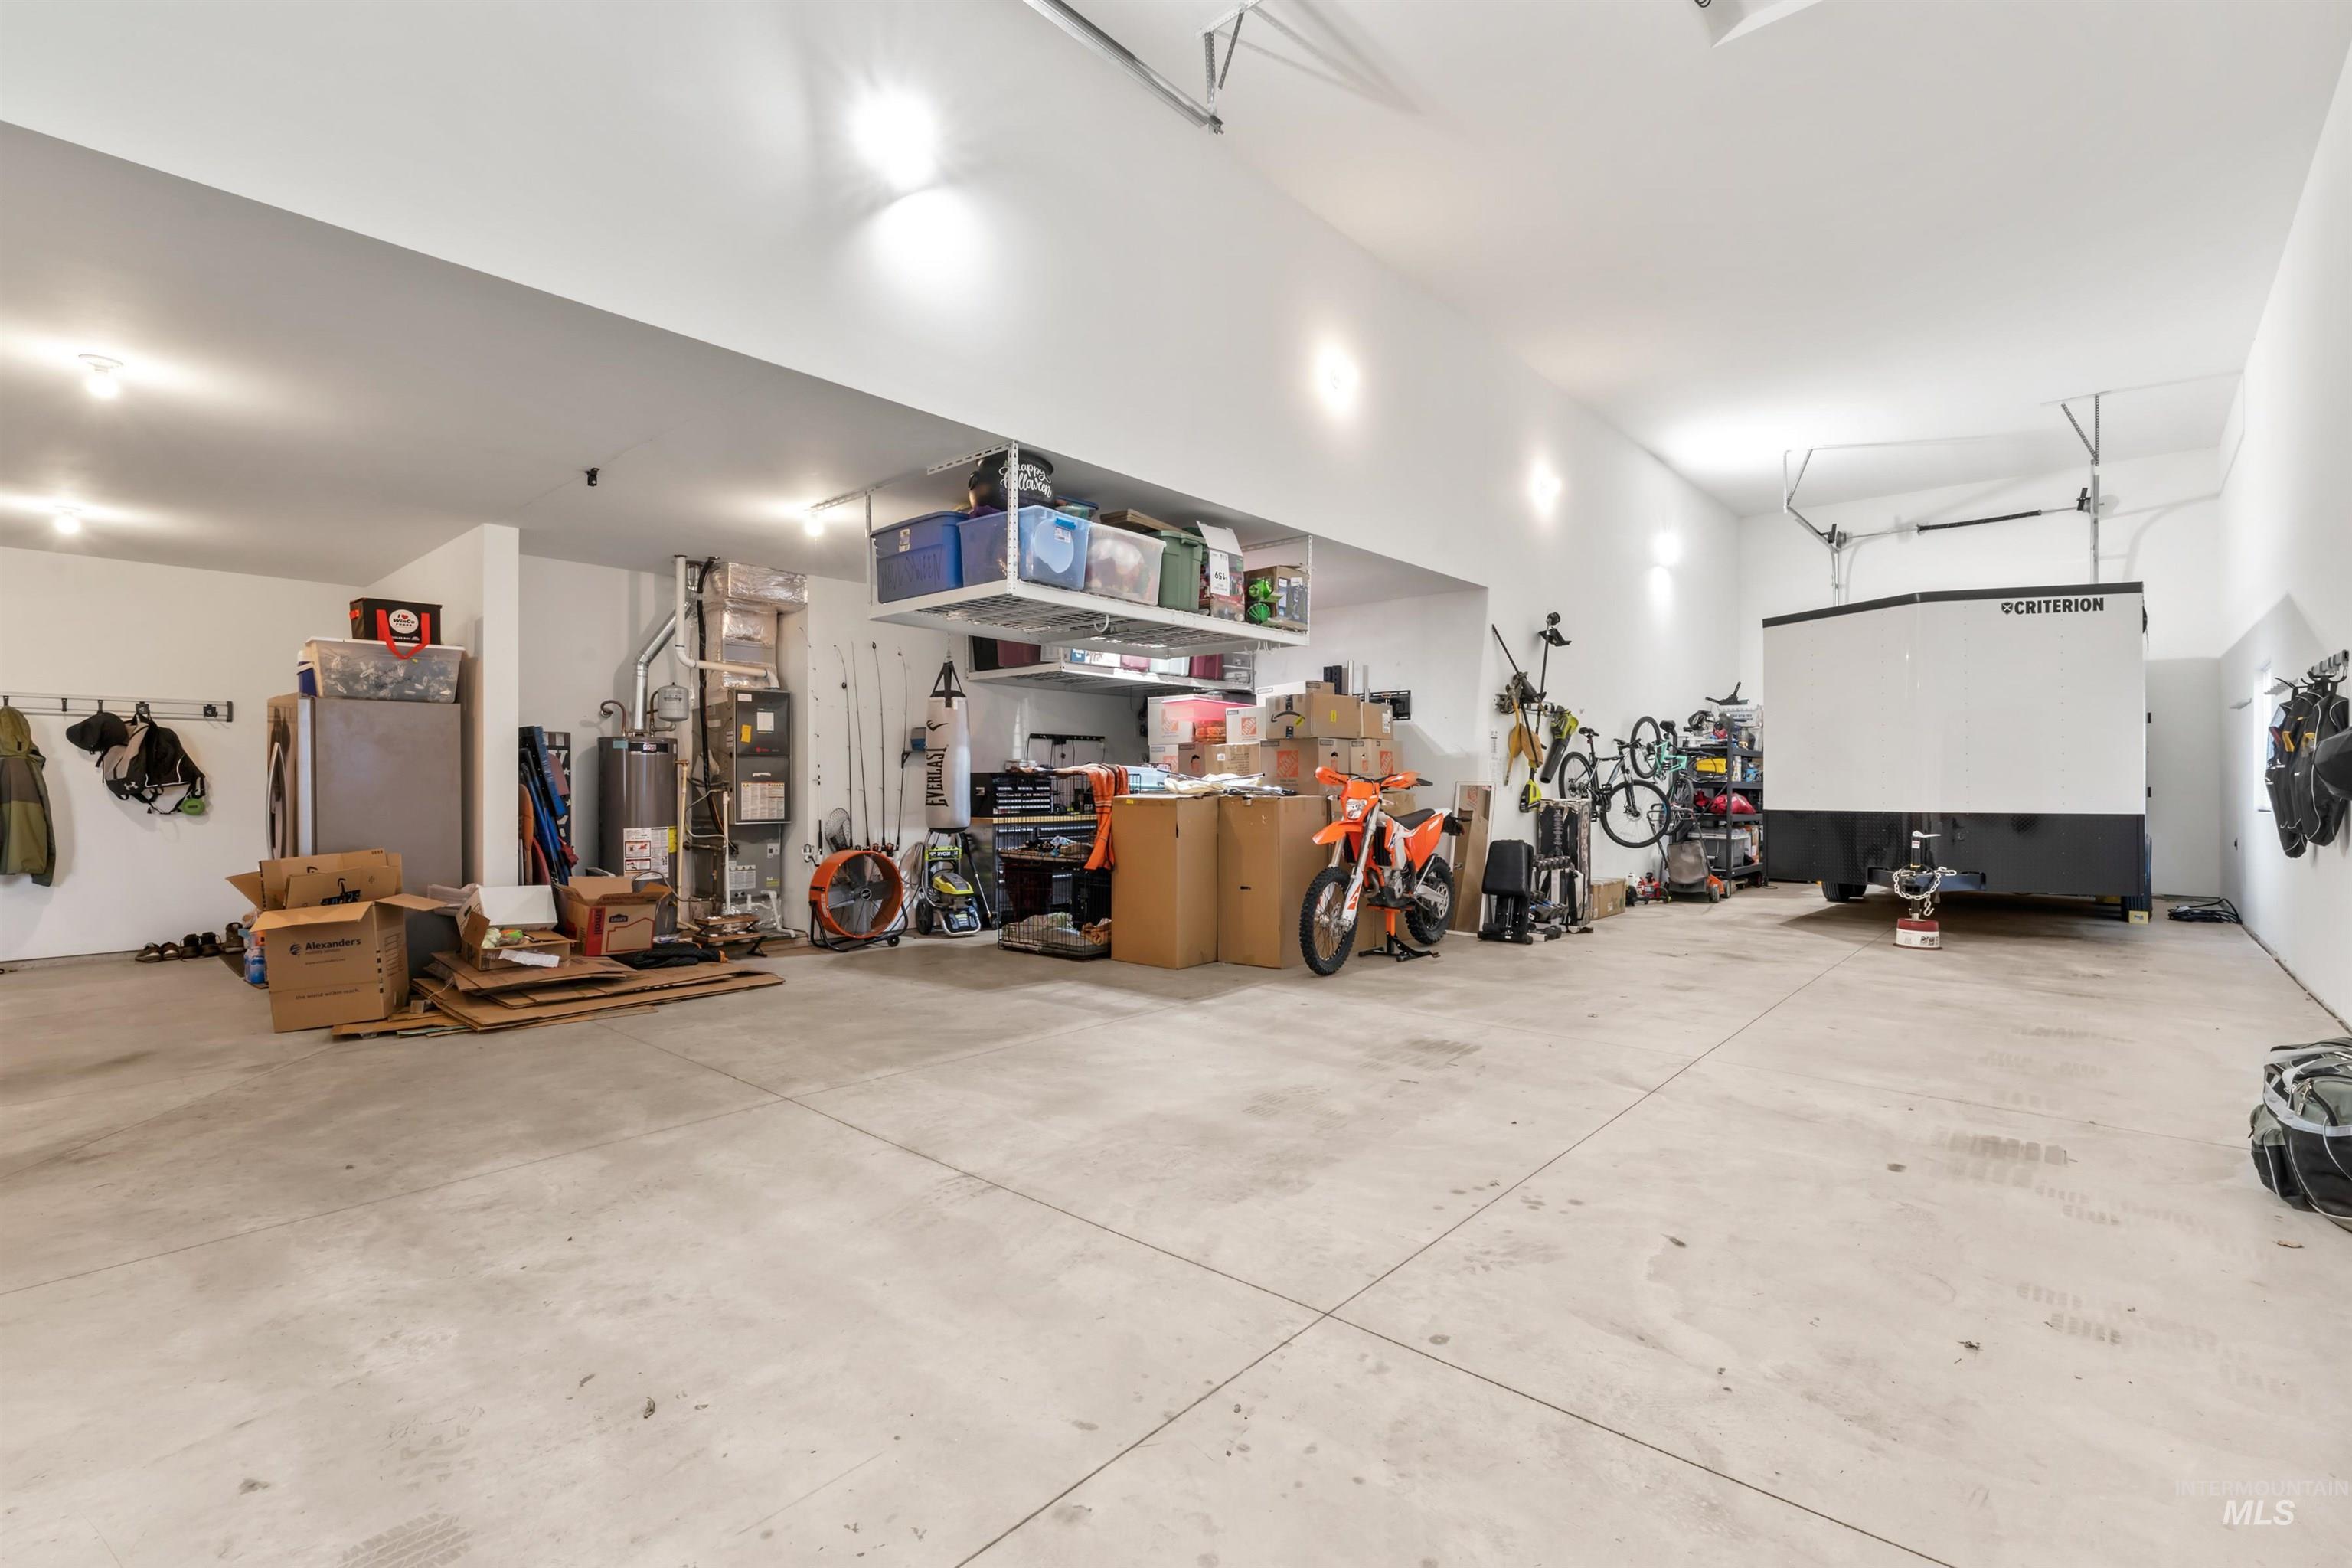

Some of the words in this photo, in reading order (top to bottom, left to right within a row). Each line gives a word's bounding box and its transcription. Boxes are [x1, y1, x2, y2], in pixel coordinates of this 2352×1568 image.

[1000, 472, 1052, 498] lloween
[2014, 597, 2104, 615] CRITERION
[926, 746, 948, 807] EVERLAST
[306, 938, 361, 950] Alexander's
